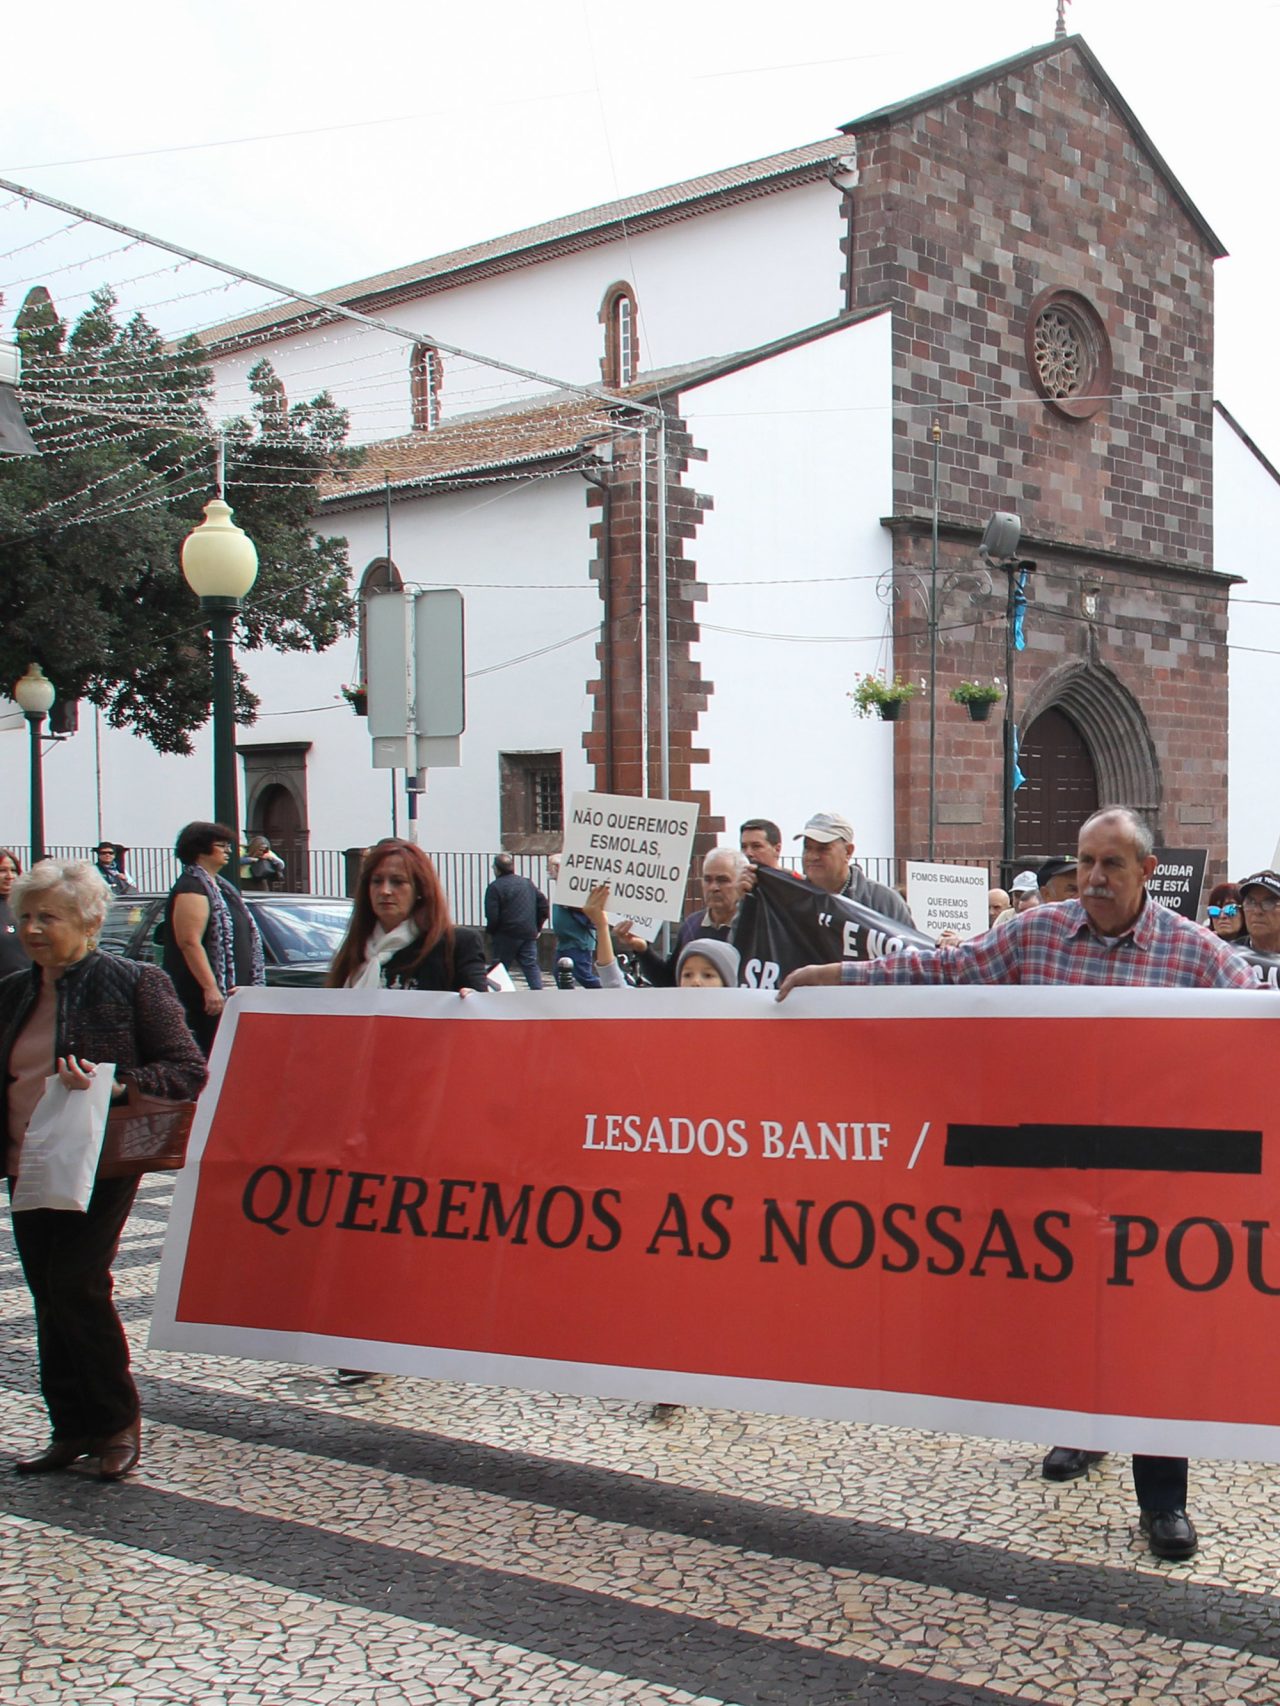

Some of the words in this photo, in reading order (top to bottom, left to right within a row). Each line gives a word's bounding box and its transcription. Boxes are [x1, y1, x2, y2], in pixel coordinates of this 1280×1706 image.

[573, 808, 603, 827] NÃO
[606, 813, 689, 836] QUEREMOS
[590, 834, 662, 858] ESMOLAS,
[565, 853, 622, 874] APENAS
[625, 862, 680, 882] AQUILO
[1153, 864, 1194, 877] OUBAR
[911, 872, 938, 882] FOMOS
[939, 874, 985, 886] ENGANADOS
[1163, 878, 1190, 893] ESTÁ
[569, 876, 598, 893] QUE
[614, 883, 669, 904] NOSSO.
[927, 897, 969, 908] QUEREMOS
[928, 909, 938, 918] AS
[939, 910, 969, 919] NOSSAS
[927, 920, 972, 932] POUPANÇAS
[582, 1114, 748, 1159] LESADOS
[761, 1120, 891, 1162] BANIF
[241, 1163, 622, 1253] QUEREMOS
[645, 1192, 736, 1261] AS
[759, 1197, 1074, 1284] NOSSAS
